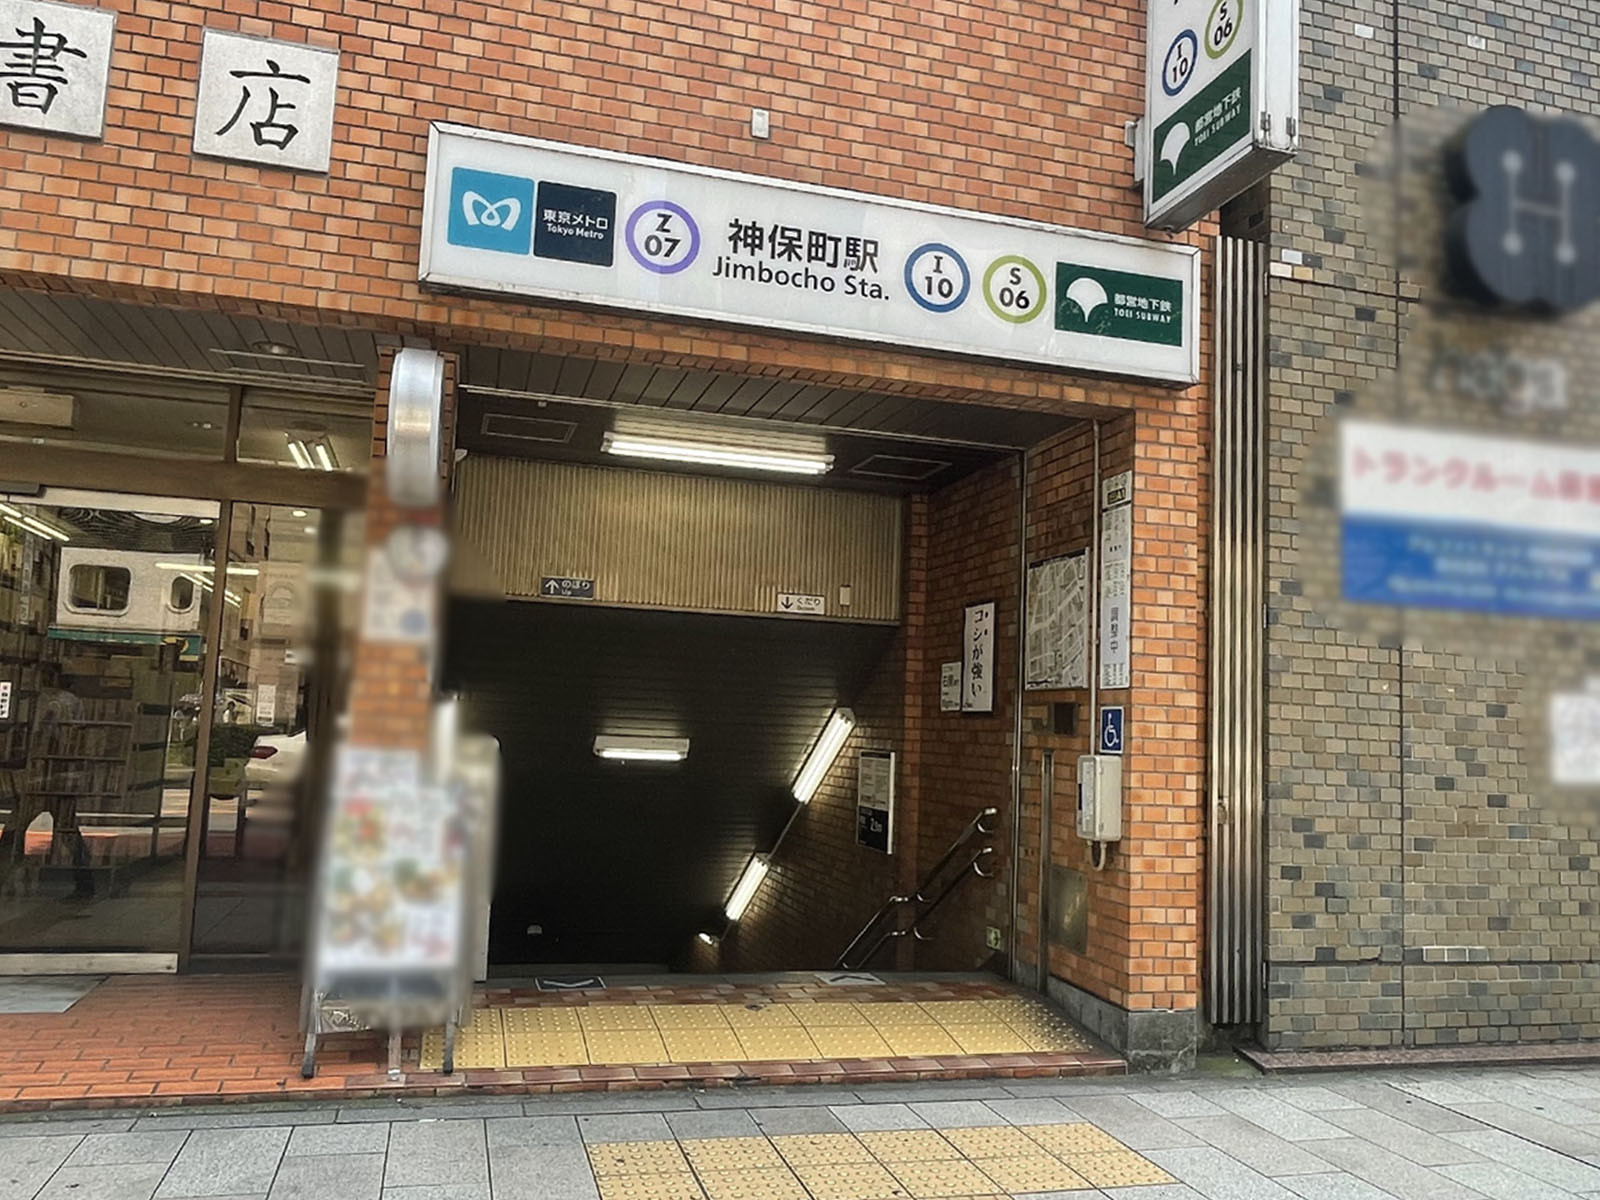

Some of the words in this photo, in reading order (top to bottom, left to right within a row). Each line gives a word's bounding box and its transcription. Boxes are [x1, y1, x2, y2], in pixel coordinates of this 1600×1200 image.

[1220, 2, 1227, 20] S
[1214, 18, 1233, 46] 06
[1177, 43, 1183, 60] I
[1173, 58, 1188, 83] 10
[1211, 103, 1241, 134] SUBWAY
[543, 209, 608, 230] 東京メトロ
[655, 213, 673, 233] Z
[546, 223, 574, 236] Tokyo
[575, 227, 604, 240] Metro
[644, 235, 681, 258] 07
[728, 218, 879, 273] 神保町駅
[933, 255, 943, 274] I
[712, 256, 835, 292] Jimbocho
[844, 275, 889, 300] Sta.
[1009, 267, 1022, 285] S
[925, 276, 953, 299] 10
[999, 287, 1030, 309] 06
[1114, 293, 1172, 313] 都営地下鉄
[1114, 308, 1133, 319] TOEI
[1136, 312, 1171, 324] SUBWAY
[797, 597, 821, 606] くだり
